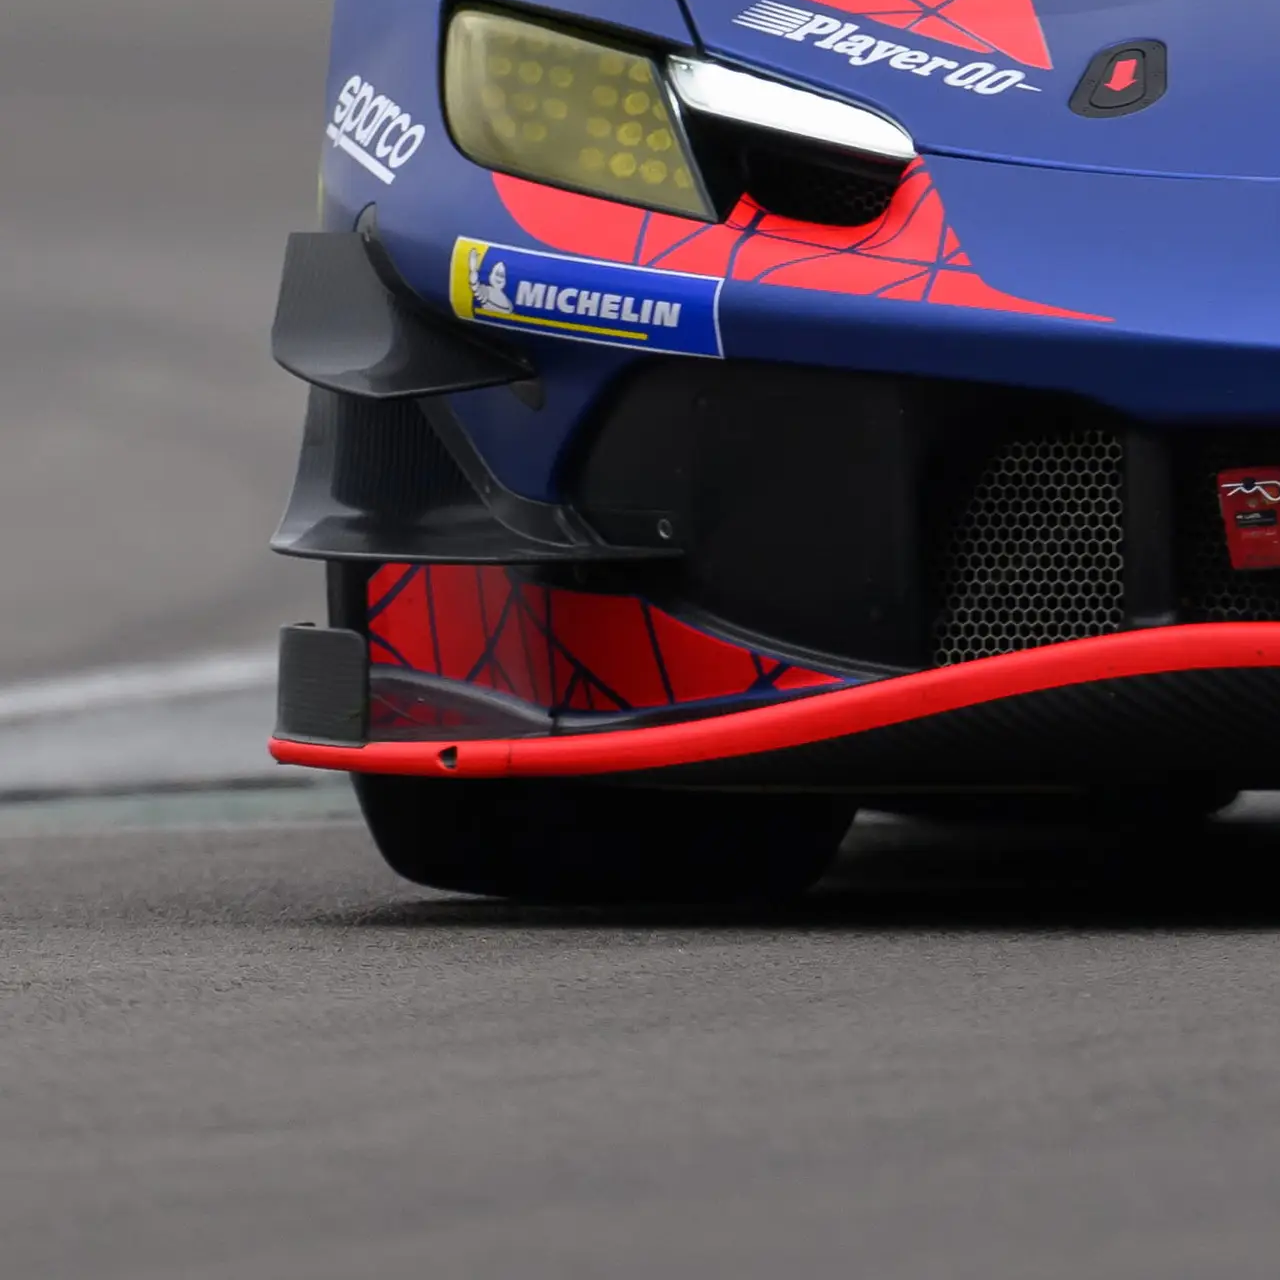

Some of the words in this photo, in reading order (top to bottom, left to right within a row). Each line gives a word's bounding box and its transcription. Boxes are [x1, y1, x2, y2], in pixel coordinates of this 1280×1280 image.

[784, 14, 959, 76] Player
[333, 75, 426, 169] sparco
[515, 280, 682, 328] MICHELIN
